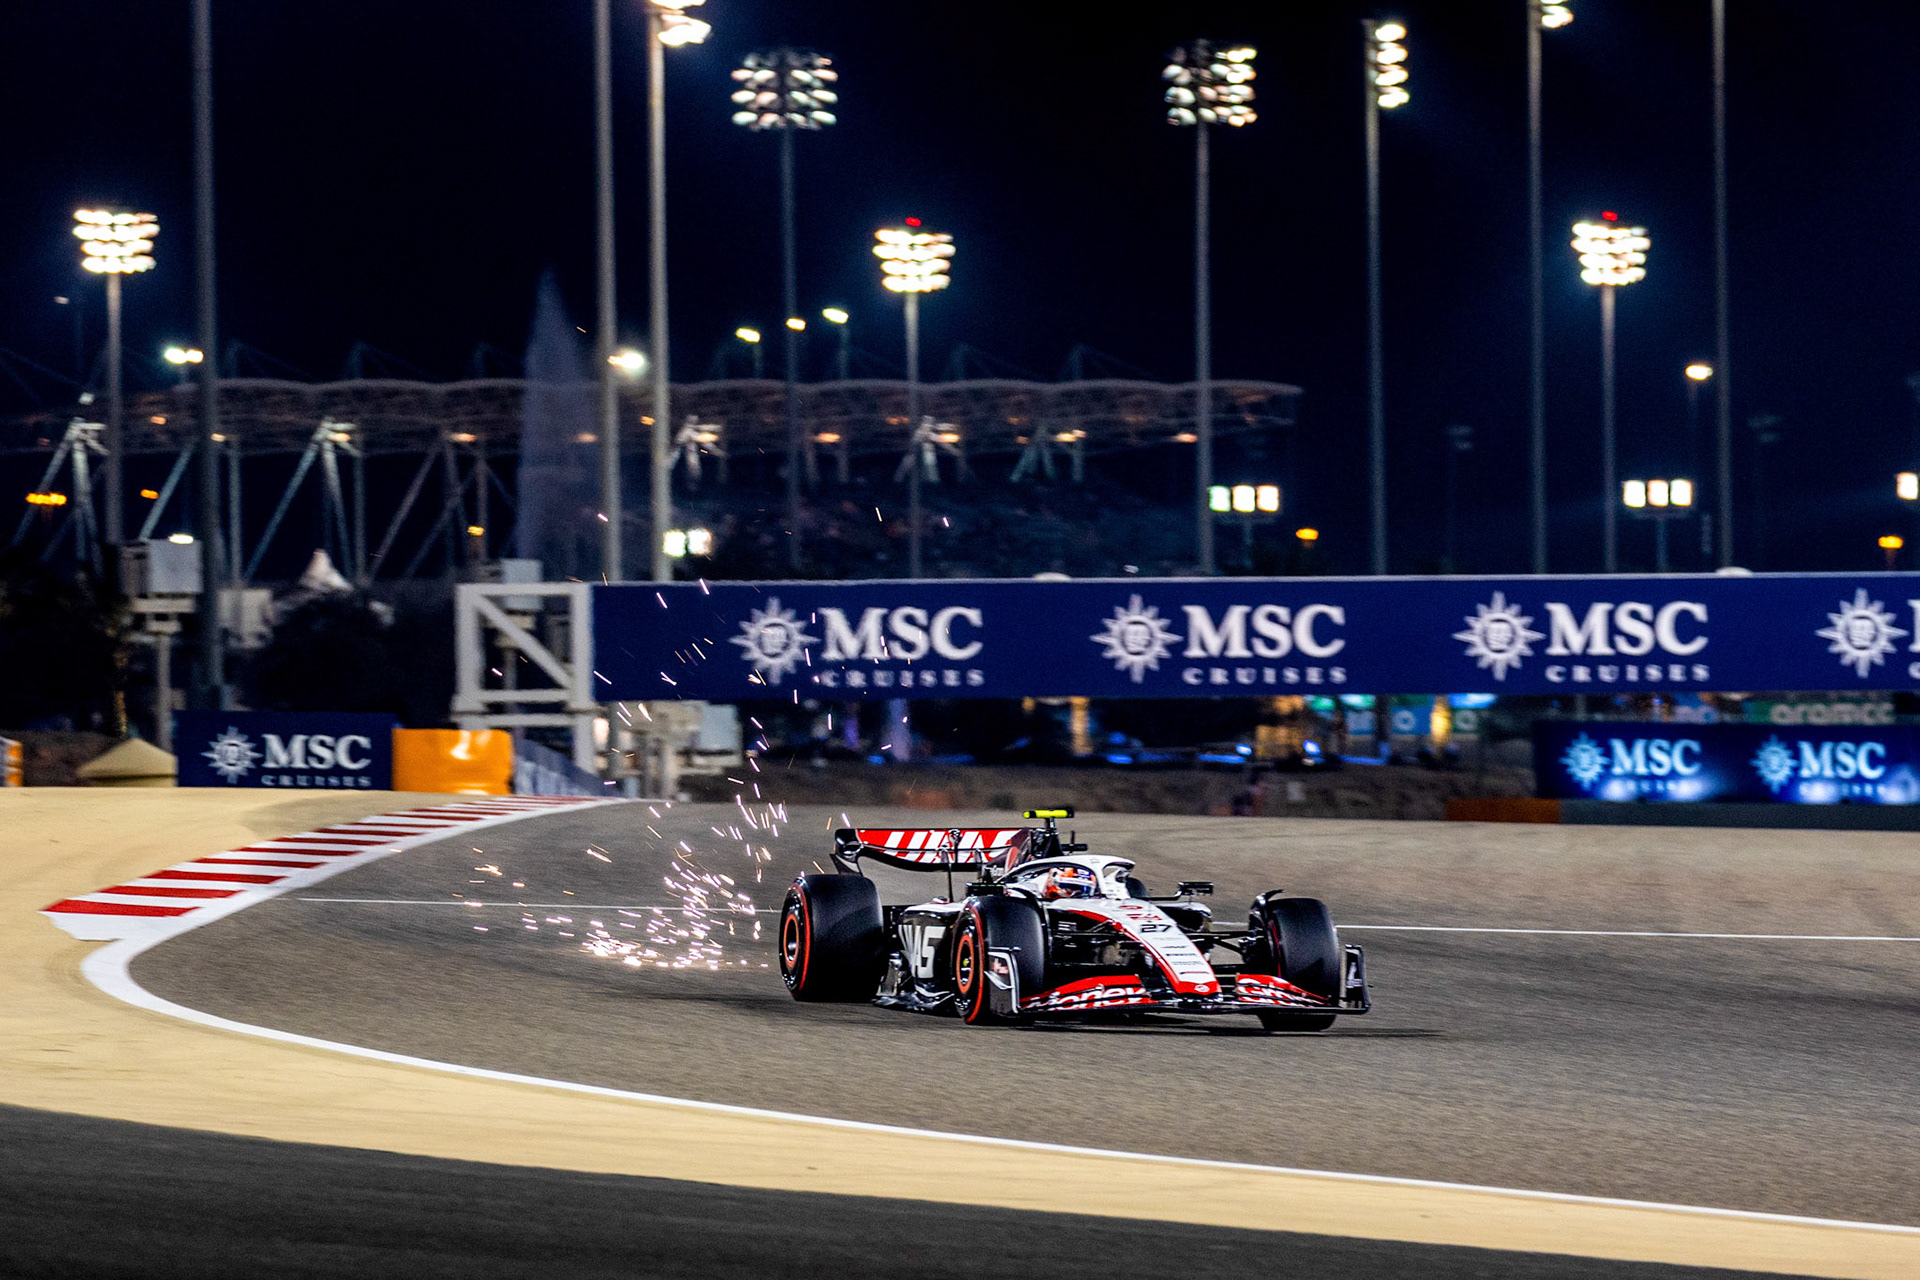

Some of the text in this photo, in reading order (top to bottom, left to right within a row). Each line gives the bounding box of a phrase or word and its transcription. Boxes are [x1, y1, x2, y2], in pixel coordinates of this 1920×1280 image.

[819, 606, 983, 660] MSC
[1182, 604, 1346, 658] MSC
[1545, 601, 1709, 656] MSC
[822, 669, 984, 688] CRUISES
[1183, 666, 1347, 685] CRUISES
[1545, 664, 1710, 683] CRUISES
[261, 733, 372, 770] MSC
[1609, 738, 1701, 776] MSC
[1797, 741, 1887, 780] MSC
[1139, 923, 1172, 933] 27
